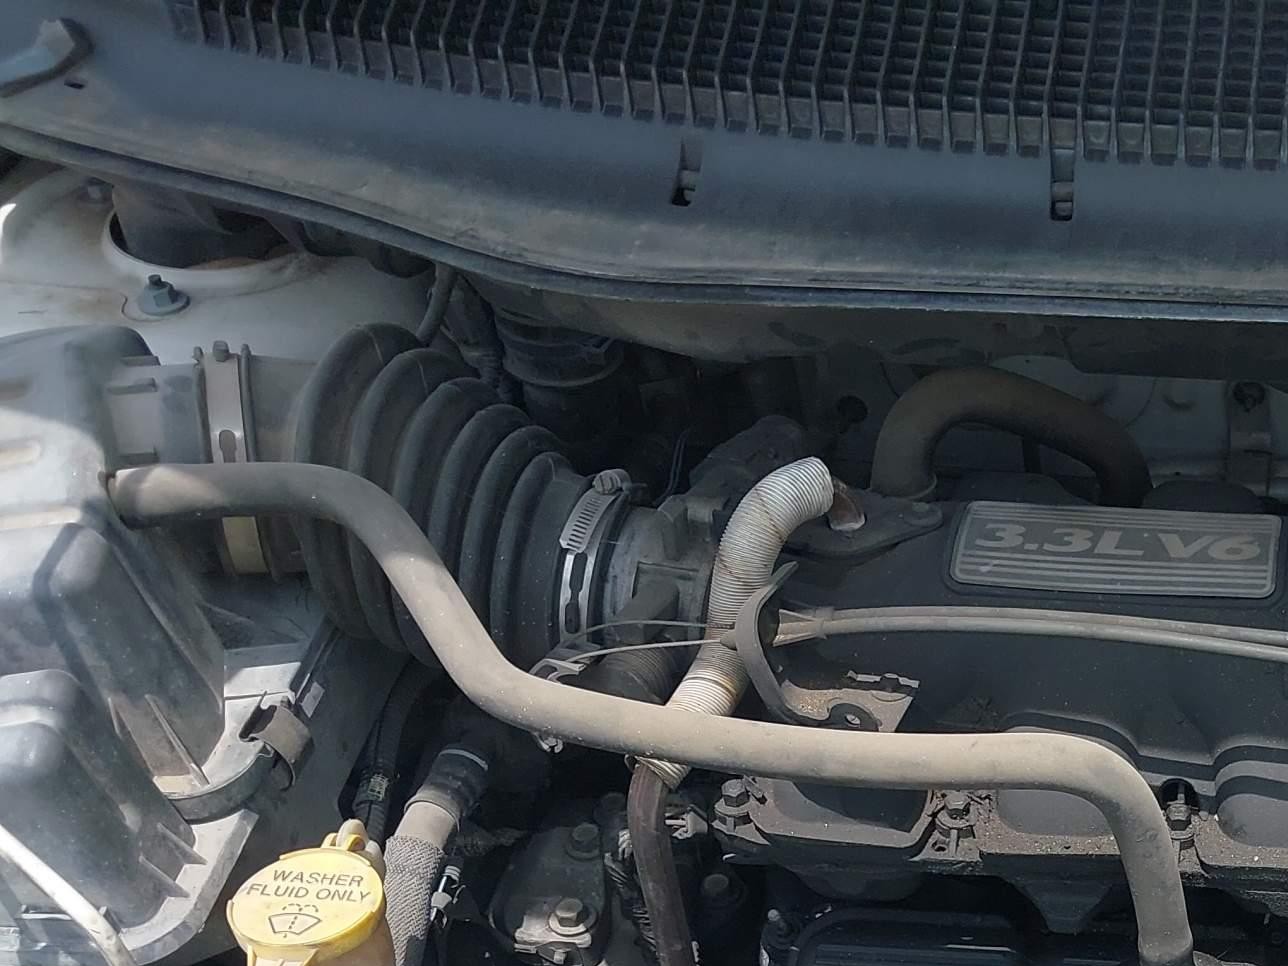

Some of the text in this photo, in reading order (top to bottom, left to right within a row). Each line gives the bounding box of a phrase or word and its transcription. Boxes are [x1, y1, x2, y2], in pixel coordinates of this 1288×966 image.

[975, 523, 1260, 561] 3.3L V6
[273, 869, 364, 887] WASHER
[246, 883, 371, 903] FLUID ONLY
